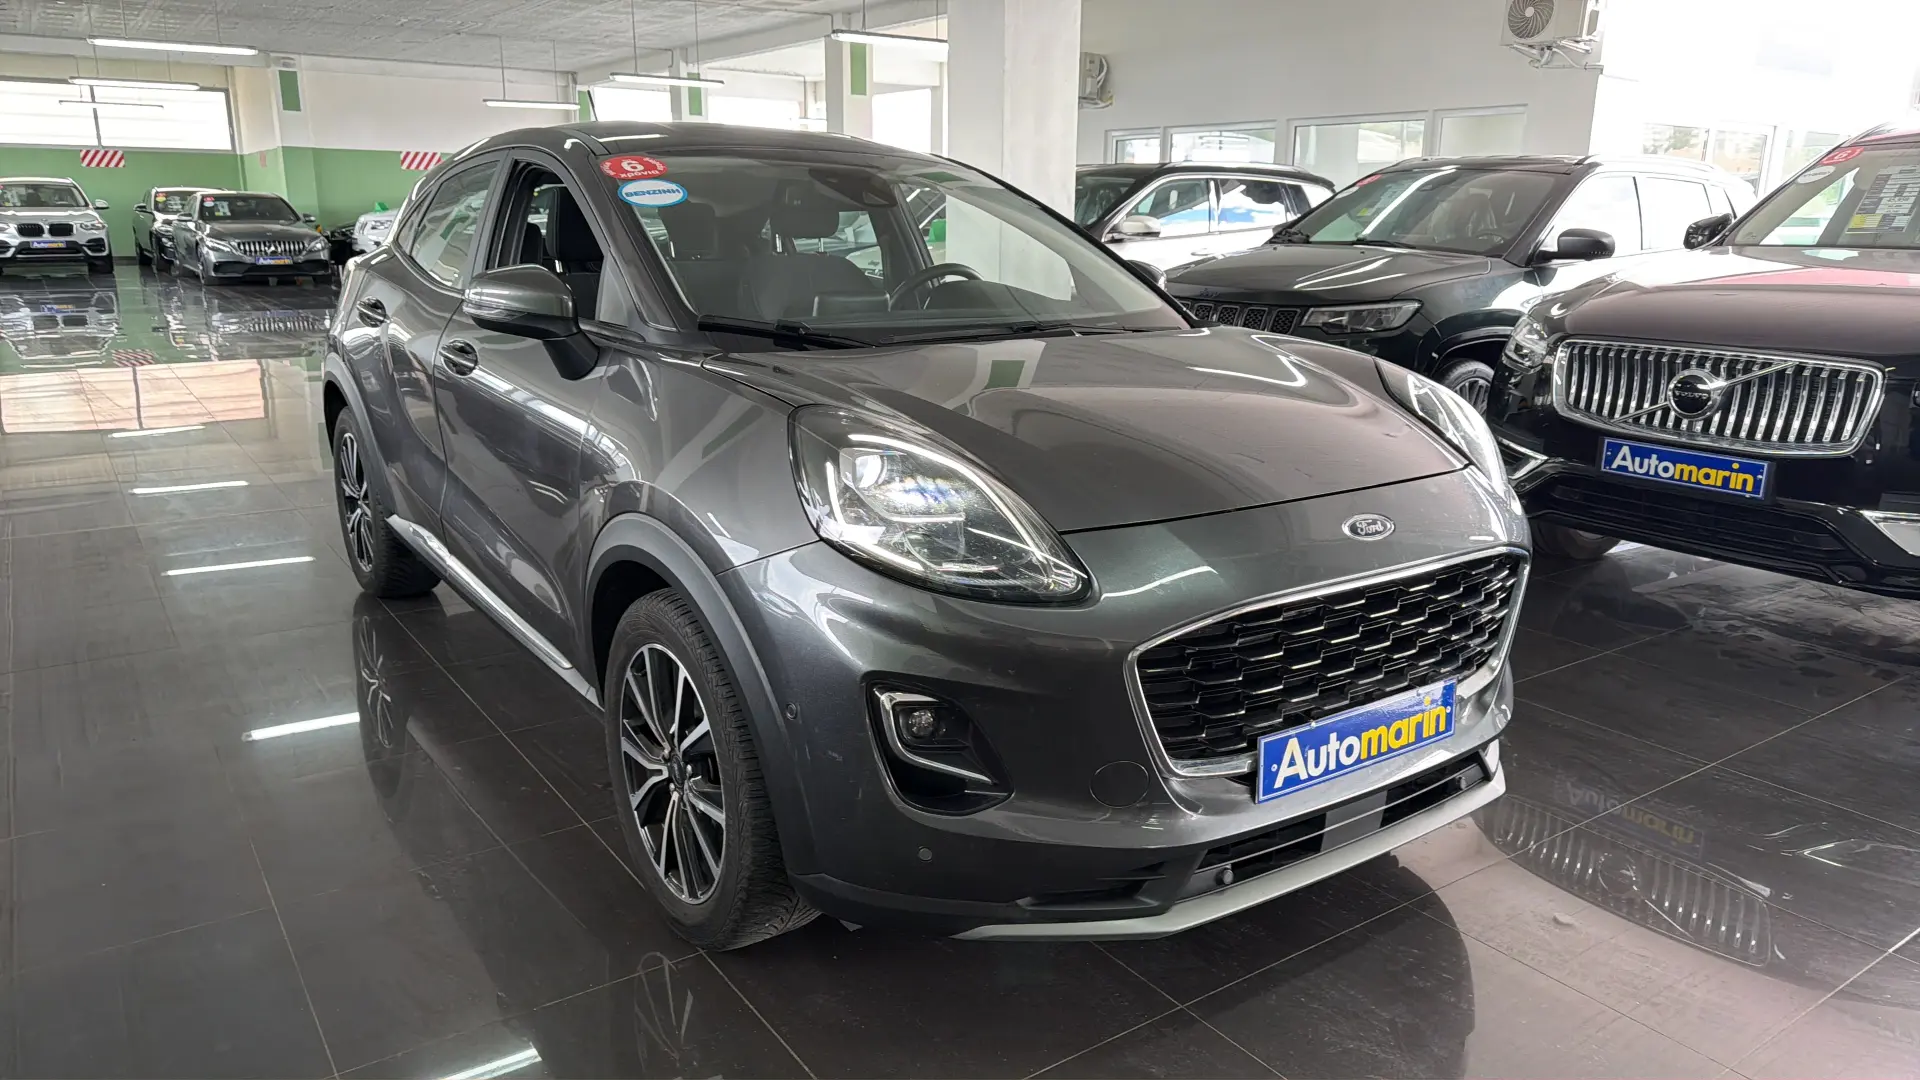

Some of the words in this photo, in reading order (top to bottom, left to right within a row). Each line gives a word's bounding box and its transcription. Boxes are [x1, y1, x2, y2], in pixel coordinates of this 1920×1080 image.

[621, 160, 644, 172] 6
[1611, 445, 1754, 492] Automarin
[1356, 519, 1384, 536] Ford
[1273, 695, 1447, 789] Automarin
